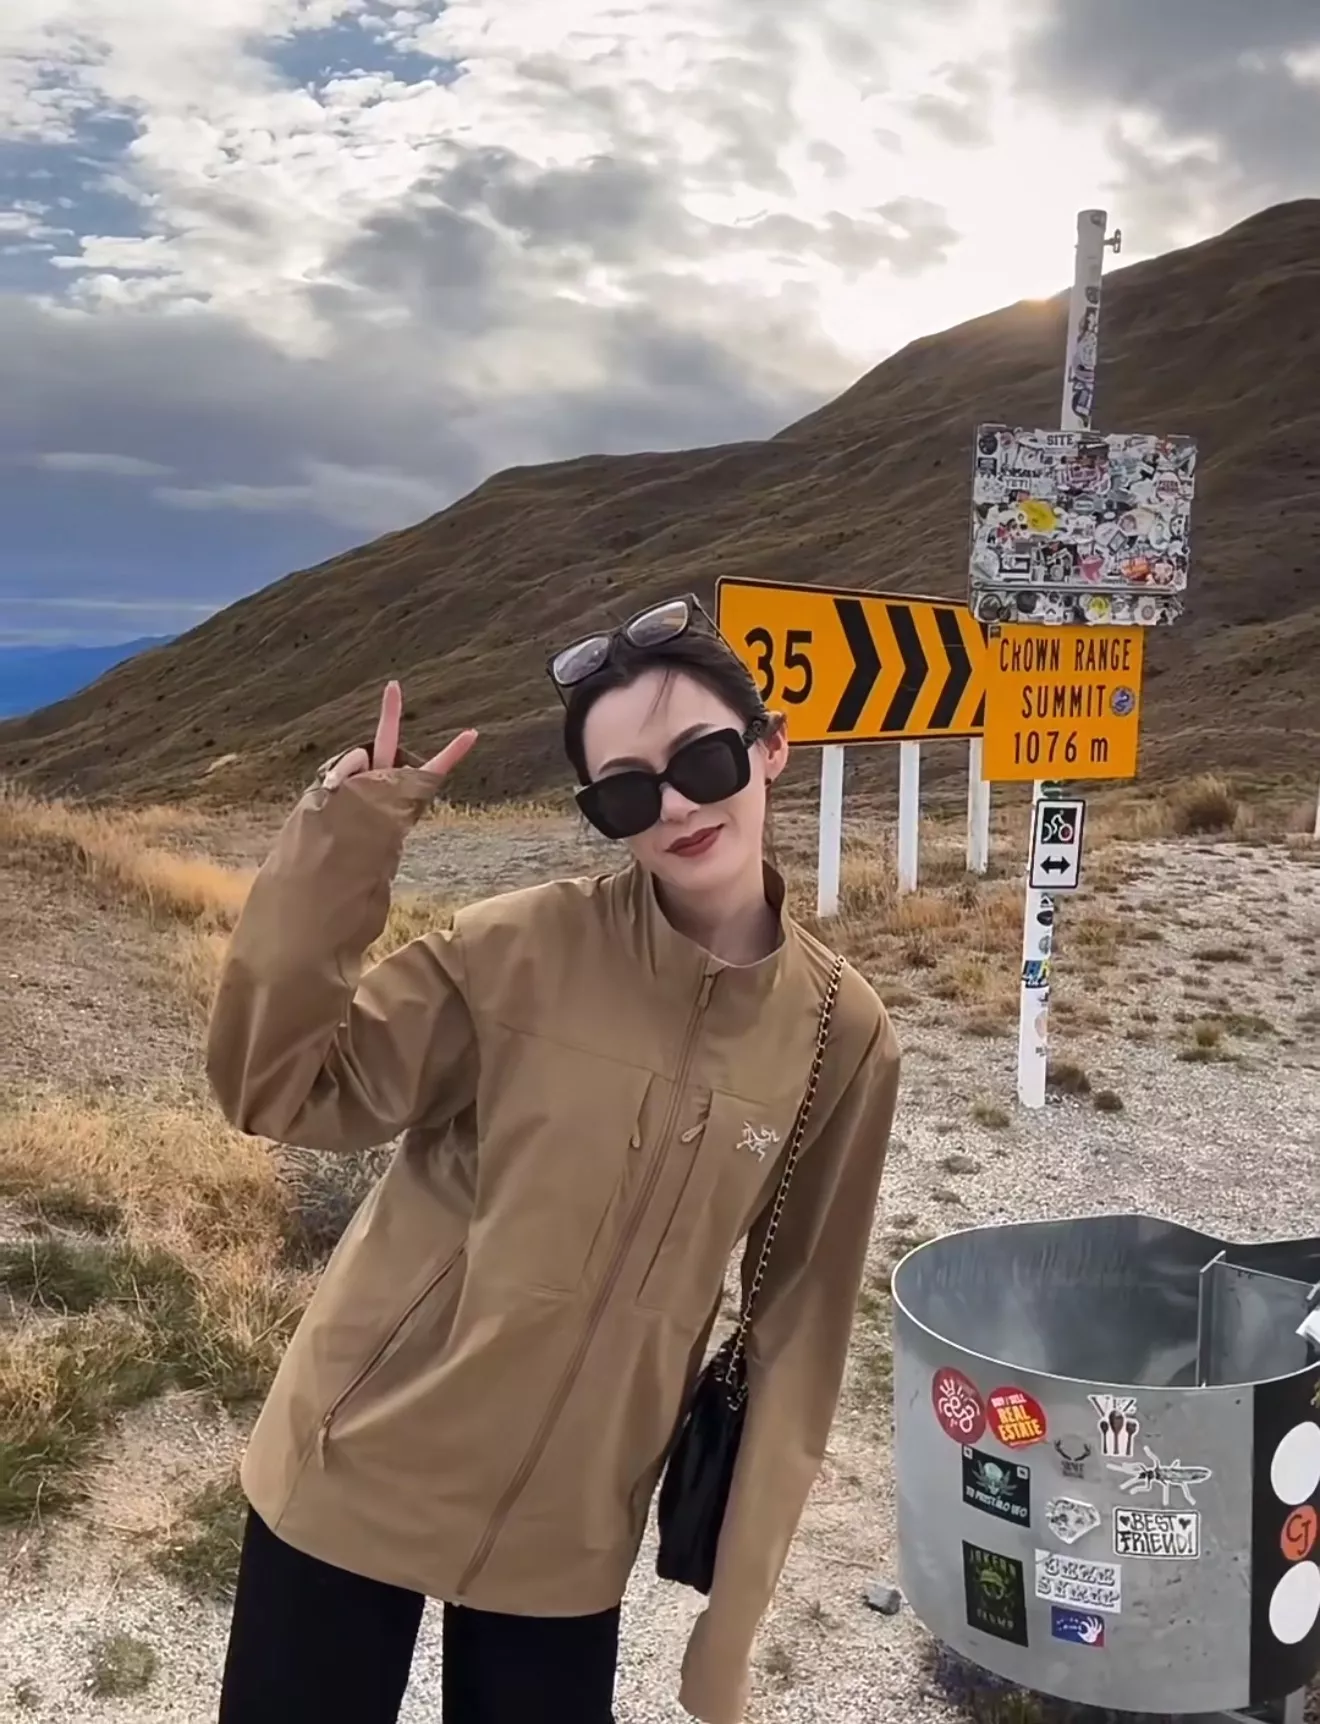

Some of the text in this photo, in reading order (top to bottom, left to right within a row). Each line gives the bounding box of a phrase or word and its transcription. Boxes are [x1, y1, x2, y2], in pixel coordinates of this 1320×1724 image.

[1047, 434, 1075, 446] SITE
[744, 626, 813, 705] 35
[1000, 638, 1132, 672] CROWN RANGE
[1022, 684, 1107, 718] SUMMIT
[1014, 730, 1109, 764] 1076 m
[996, 1404, 1031, 1424] REAL
[997, 1419, 1043, 1441] ESTATE
[1131, 1512, 1177, 1532] BEST
[1118, 1531, 1193, 1554] FRIEND!
